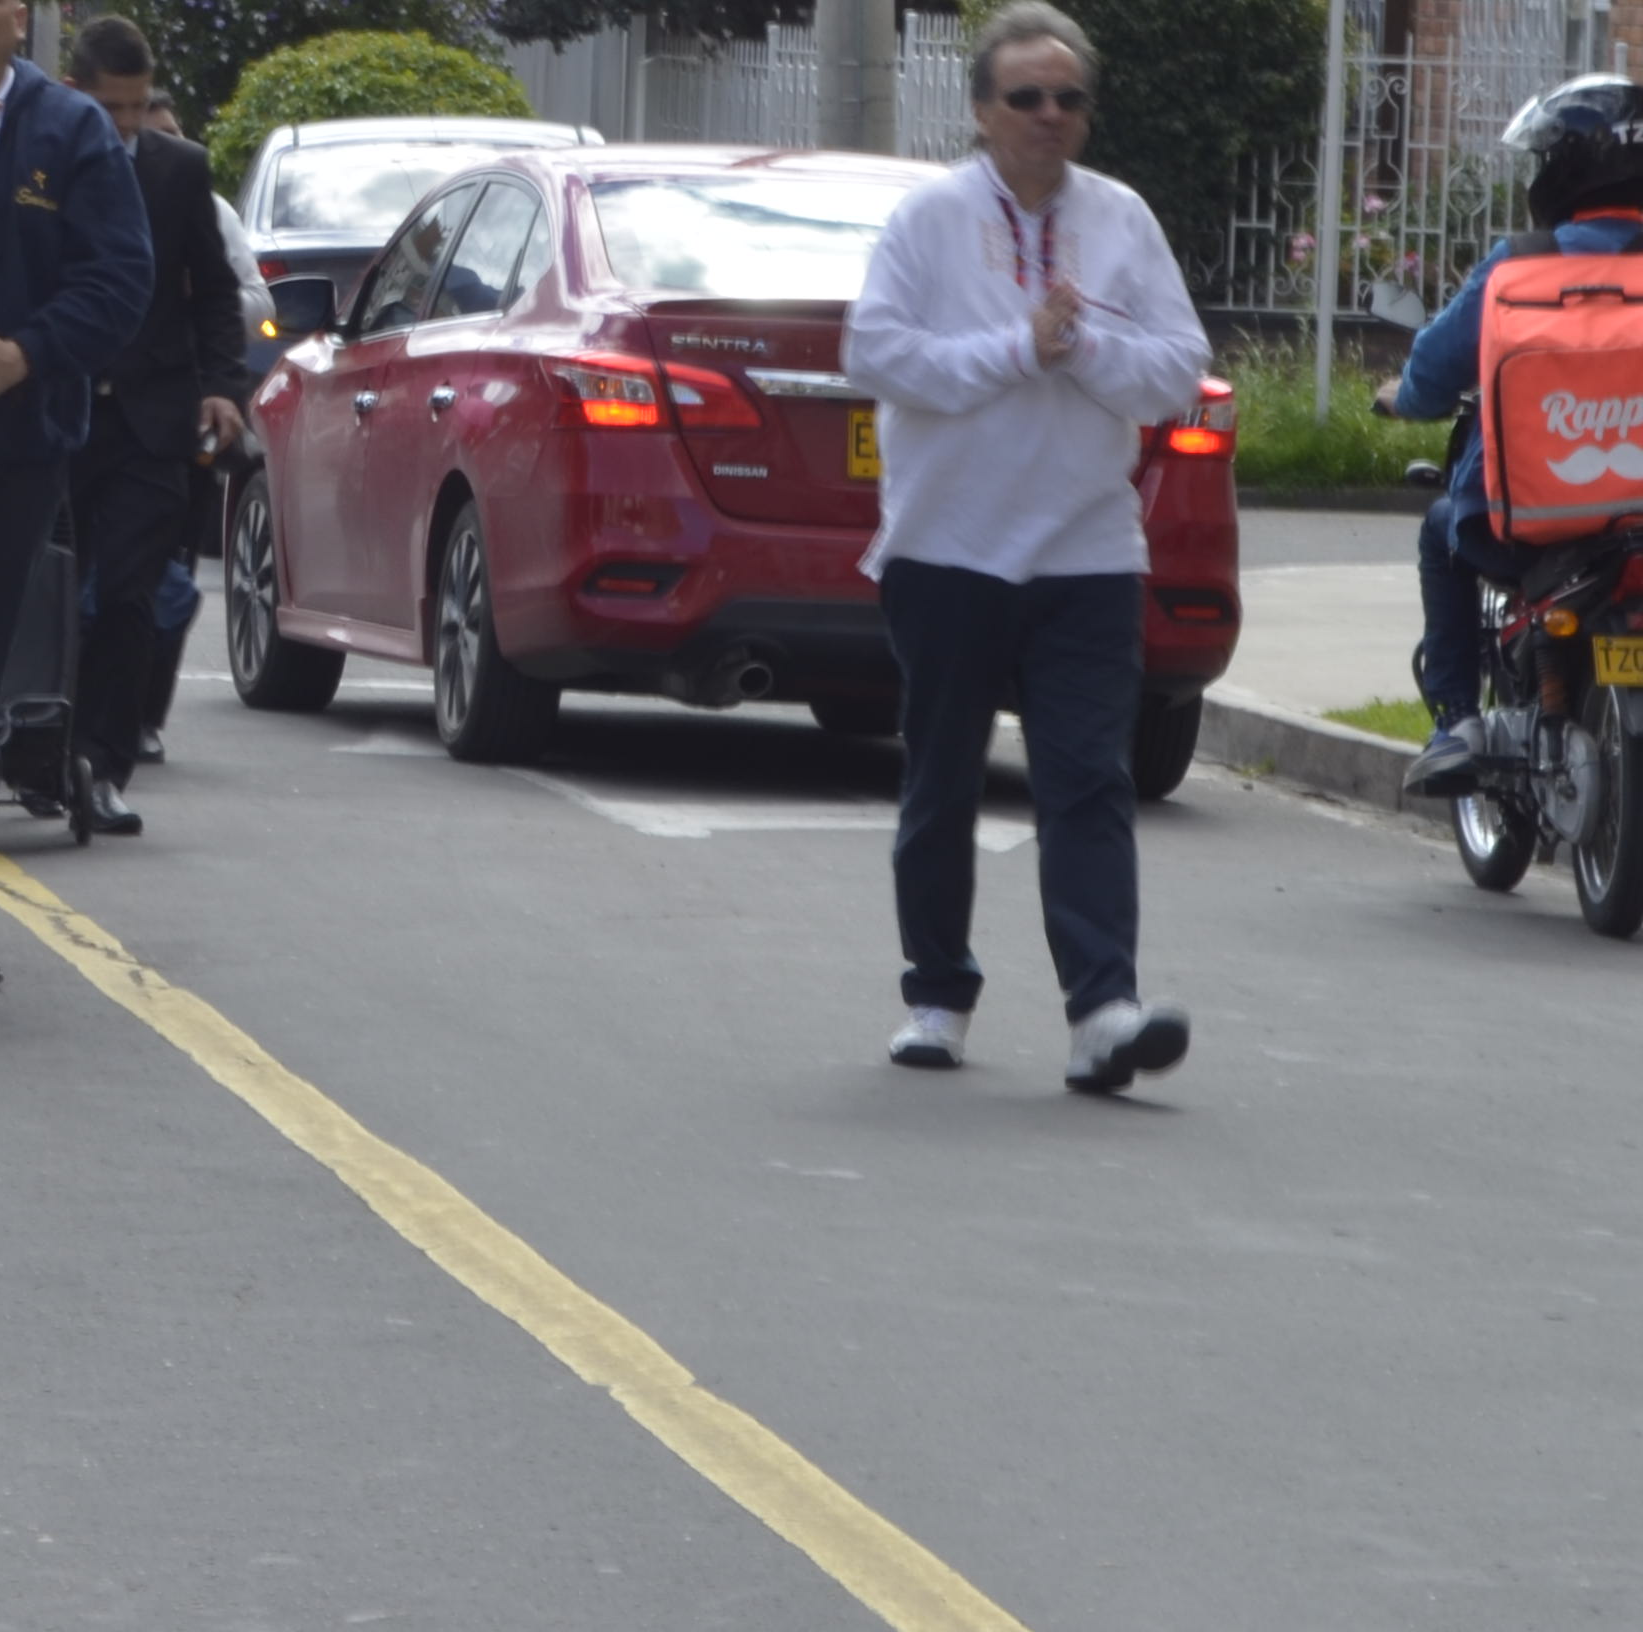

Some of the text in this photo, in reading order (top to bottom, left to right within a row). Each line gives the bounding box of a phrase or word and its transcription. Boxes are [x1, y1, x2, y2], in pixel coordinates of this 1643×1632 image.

[671, 334, 767, 353] SENTRA
[856, 423, 880, 457] E
[713, 465, 768, 479] DINISSAN
